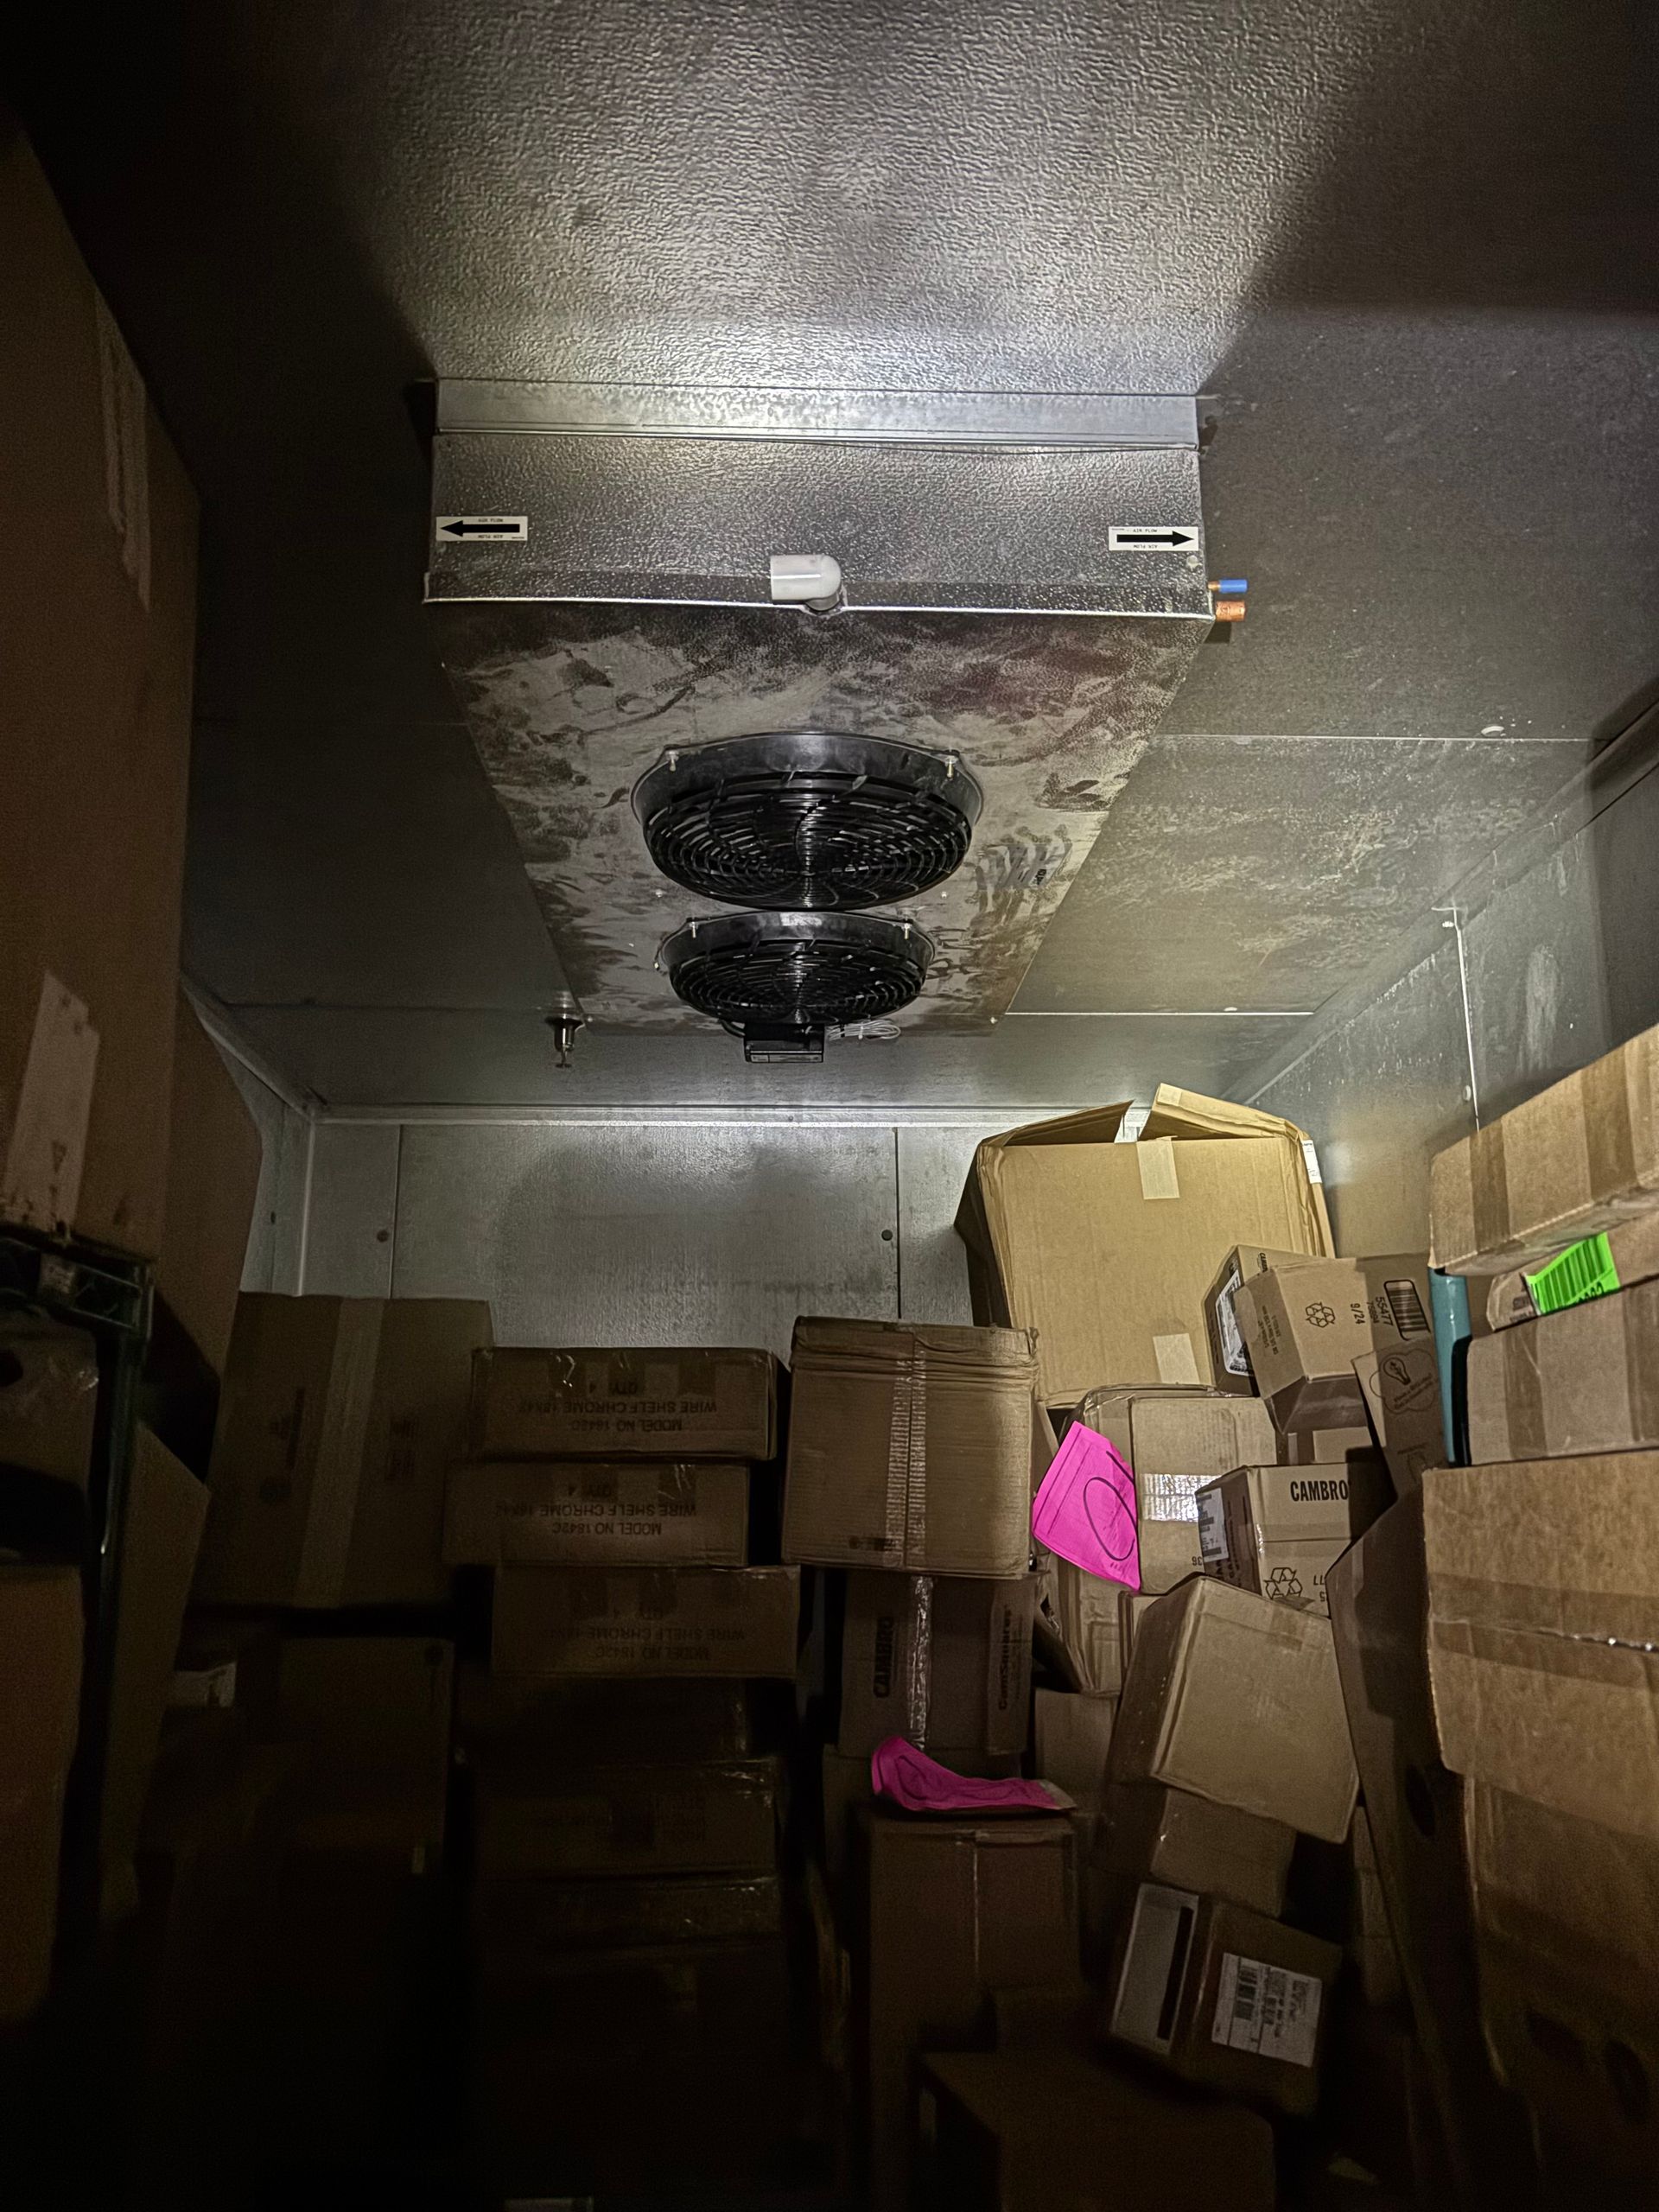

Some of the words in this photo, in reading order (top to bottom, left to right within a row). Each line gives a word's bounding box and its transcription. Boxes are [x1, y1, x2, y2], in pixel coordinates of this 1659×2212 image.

[1350, 1303, 1366, 1325] 9/24
[1375, 1296, 1394, 1326] 55477
[563, 1402, 627, 1414] CHROME
[627, 1402, 677, 1414] SHELF
[680, 1401, 717, 1414] WIRE
[639, 1419, 682, 1432] MODEL
[1291, 1479, 1349, 1502] CAMBRO
[540, 1504, 605, 1517] CHROME
[607, 1504, 656, 1517] SHELF
[659, 1504, 696, 1517] WIRE
[595, 1522, 614, 1535] NO
[617, 1522, 662, 1535] MODEL
[874, 1616, 893, 1697] CAMBRO
